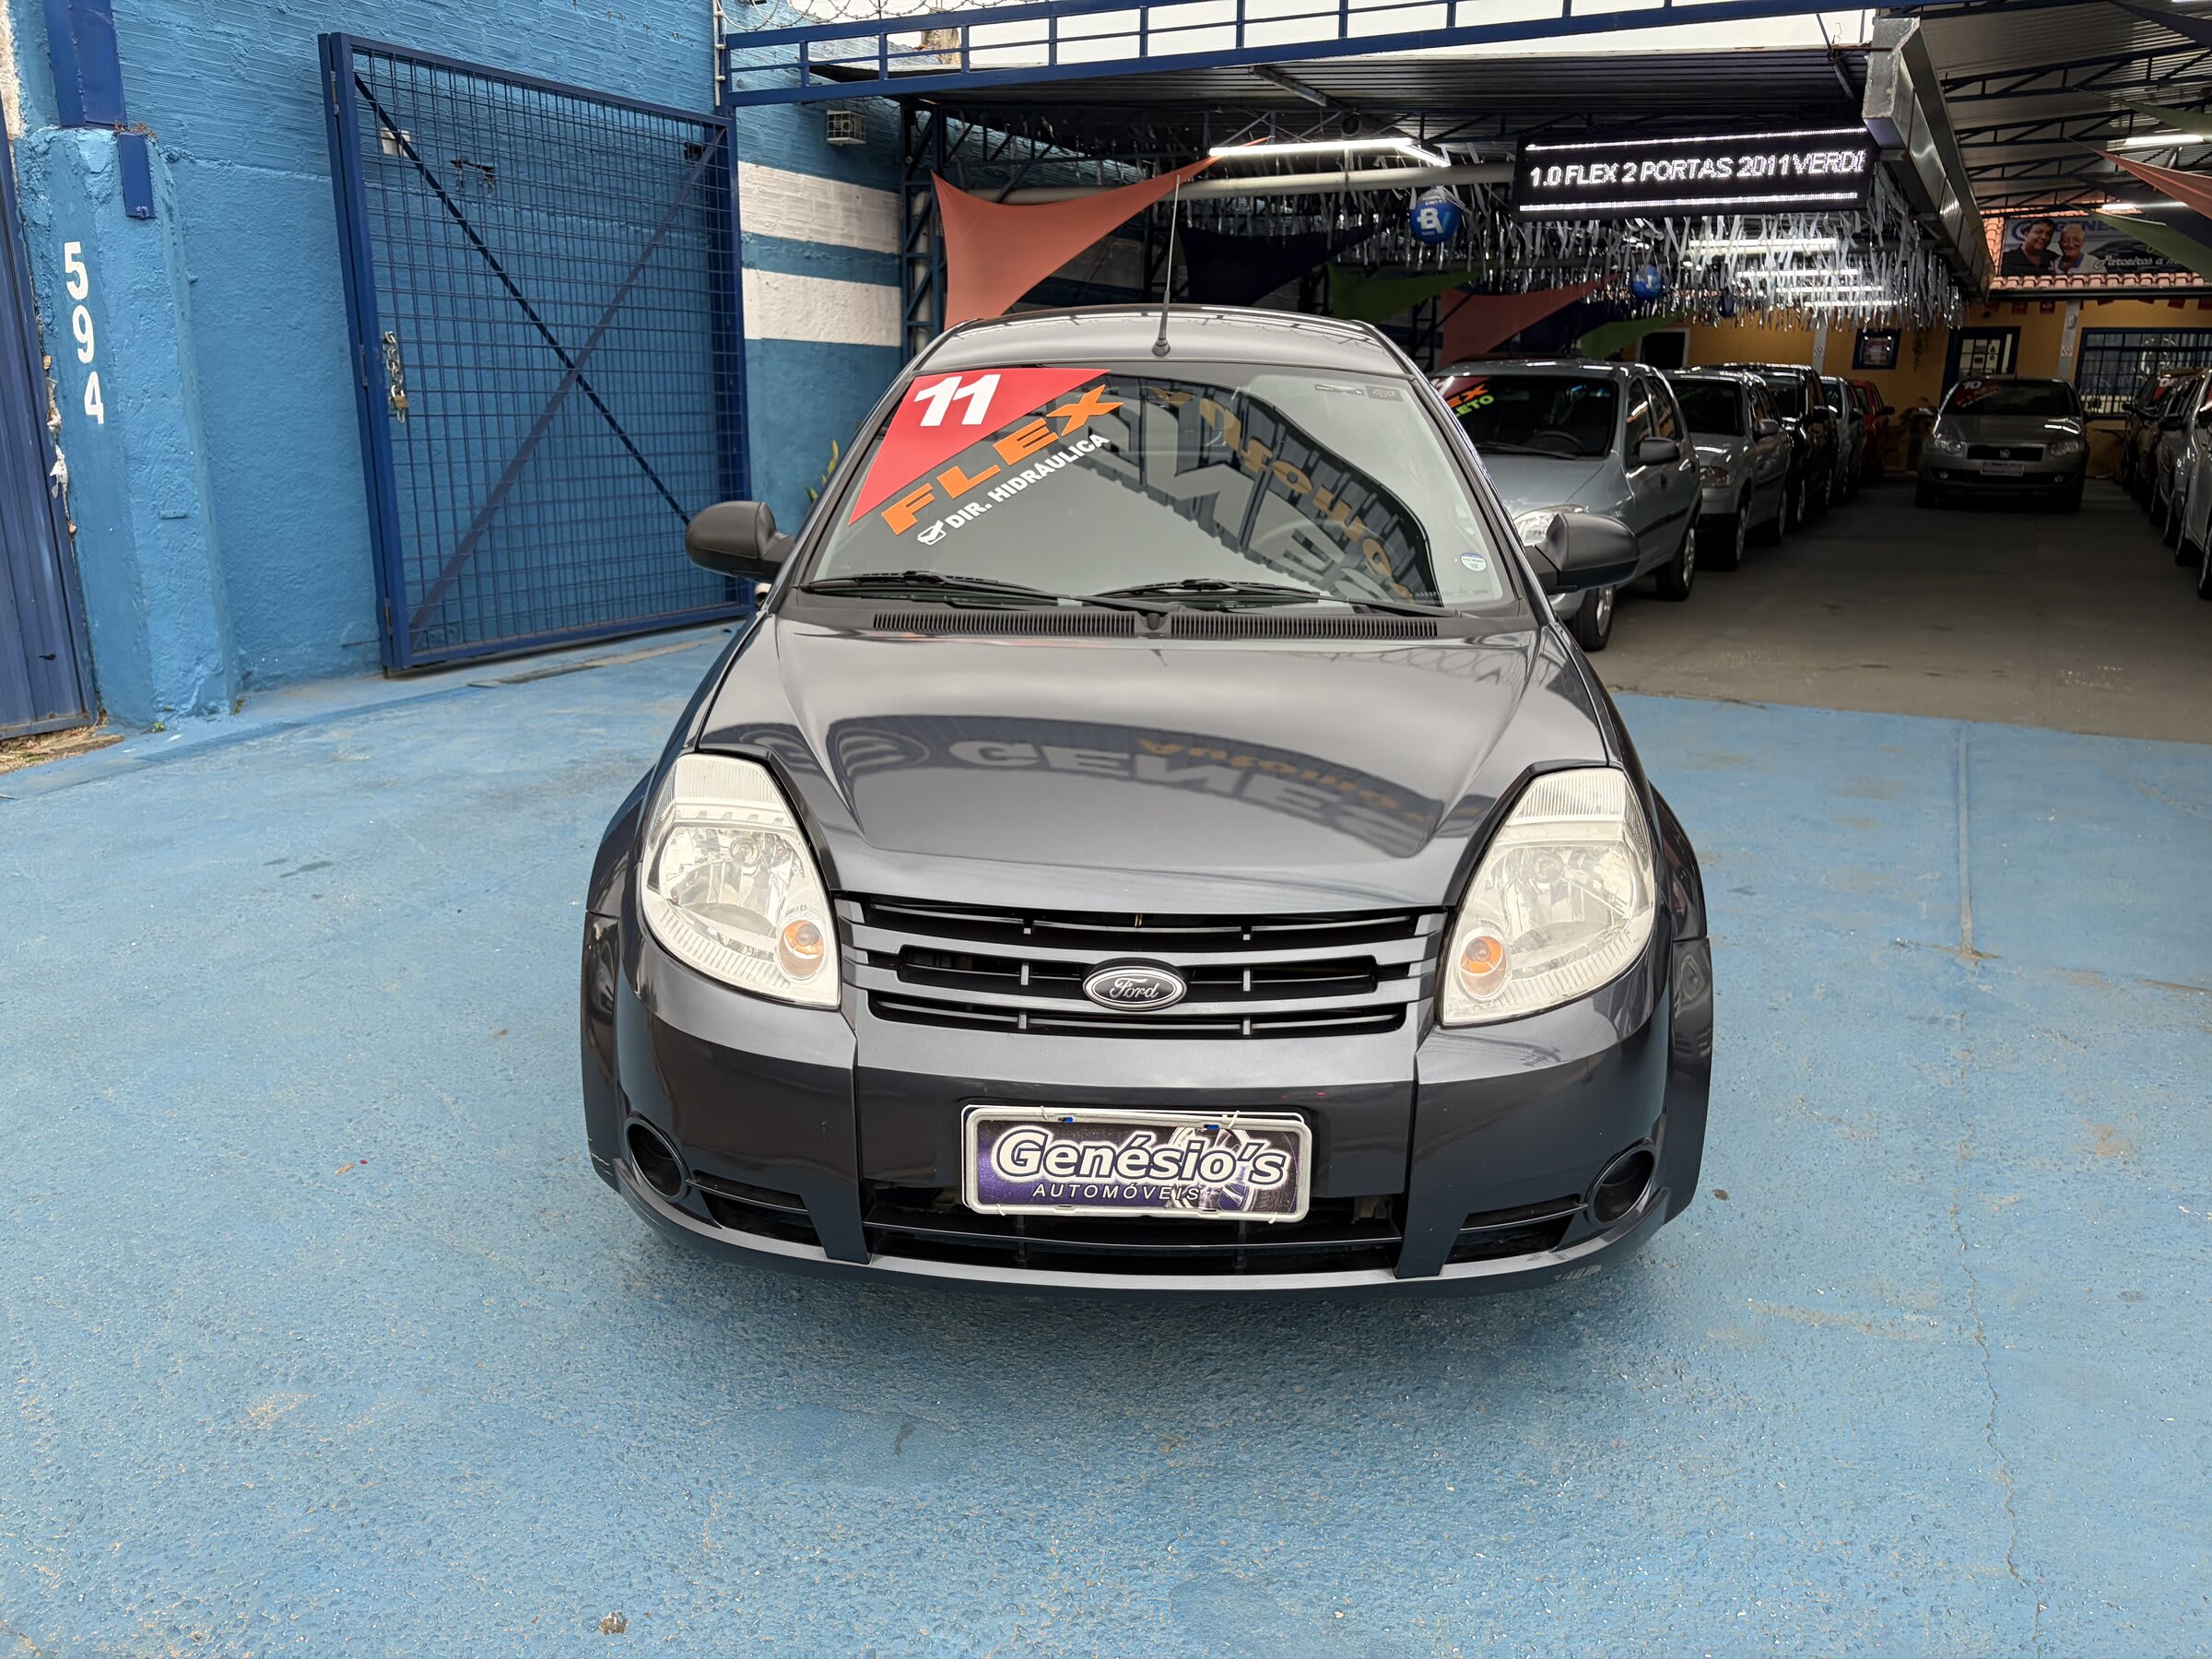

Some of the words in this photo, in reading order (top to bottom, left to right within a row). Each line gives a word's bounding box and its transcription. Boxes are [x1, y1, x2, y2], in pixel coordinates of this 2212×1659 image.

[1530, 167, 1562, 186] 1.0
[1564, 162, 1618, 185] FLEX
[1621, 162, 1638, 182] 2
[1640, 157, 1733, 182] PORTAS
[1736, 154, 1790, 178] 2011
[64, 241, 104, 424] 594
[913, 374, 1001, 427] 11
[881, 383, 1124, 536] FLEX
[945, 501, 993, 529] DIR.
[1109, 977, 1160, 999] Ford
[995, 1128, 1288, 1185] Genésio's
[1031, 1182, 1200, 1201] AUTOMÓVEIS
